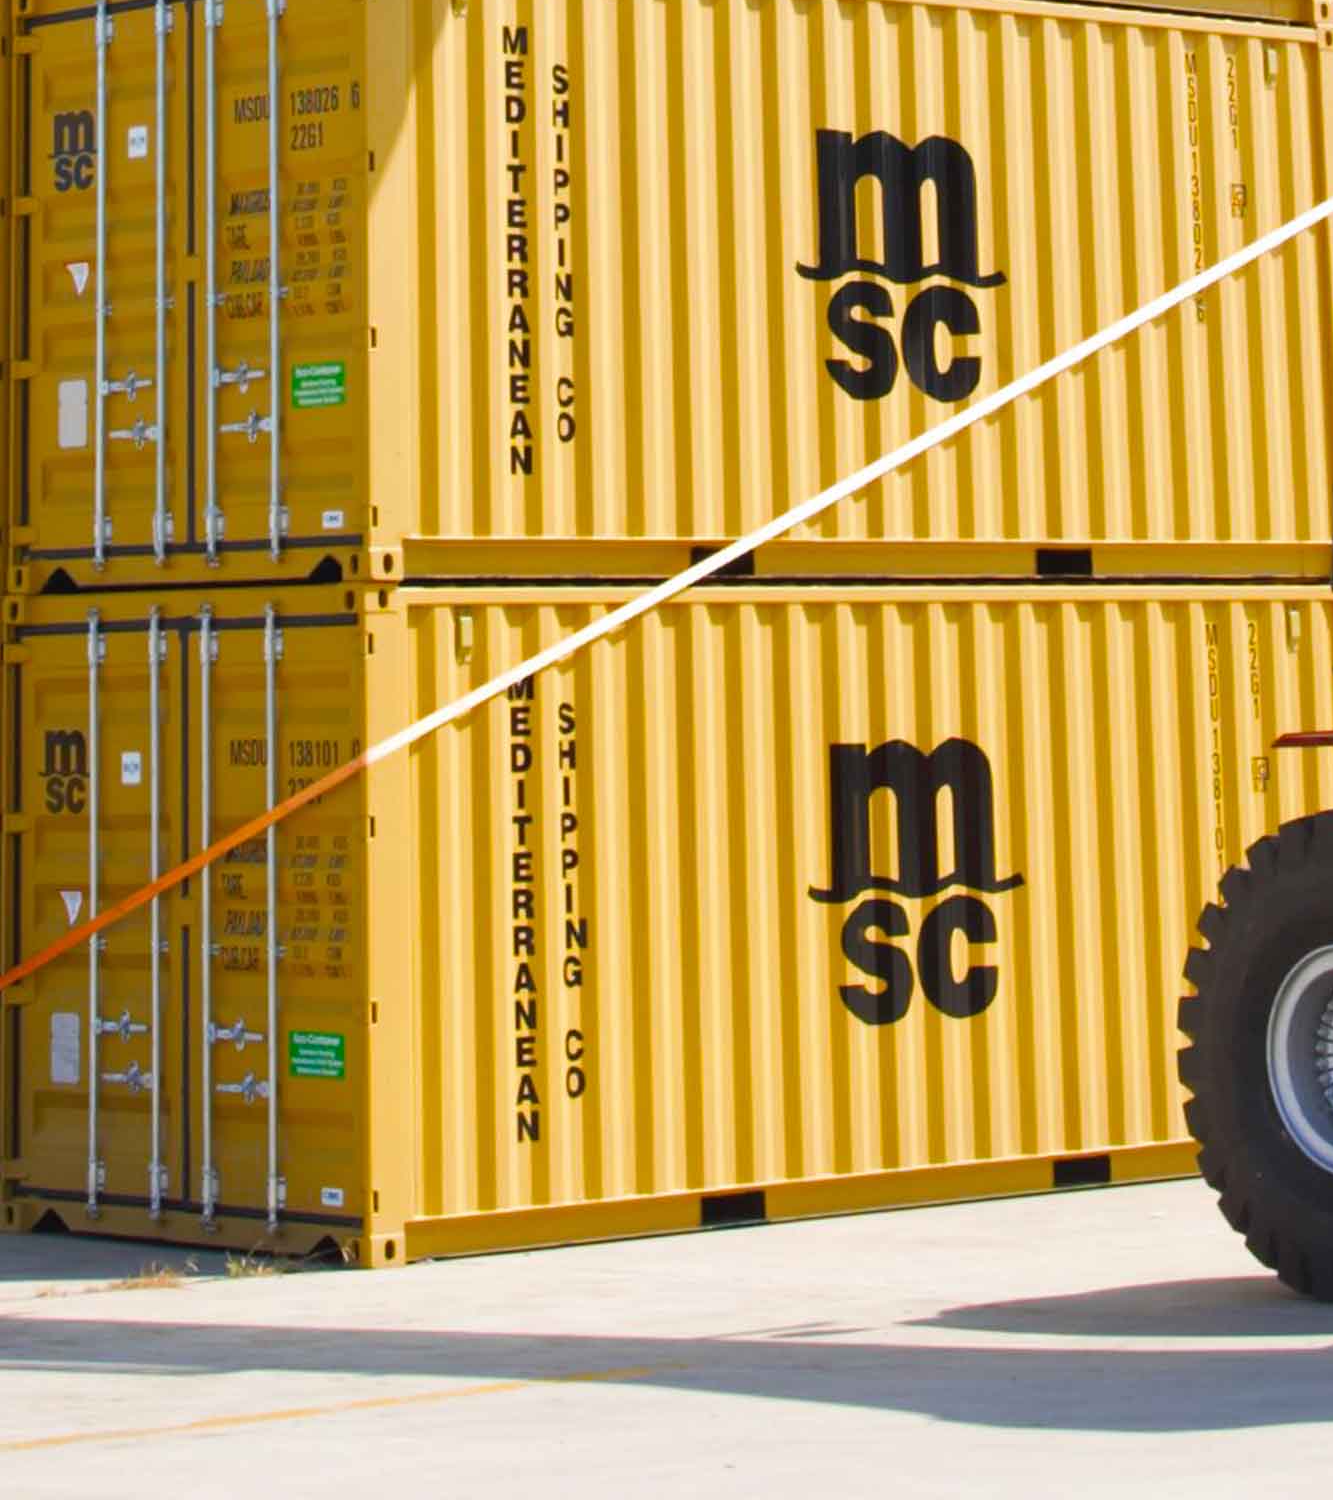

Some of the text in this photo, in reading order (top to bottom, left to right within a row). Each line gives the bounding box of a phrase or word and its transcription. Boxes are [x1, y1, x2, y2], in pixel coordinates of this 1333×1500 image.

[290, 84, 340, 117] 138026
[502, 26, 533, 476] MEDITERRANEAN
[551, 64, 576, 443] SHIPPING CO
[288, 739, 340, 768] 138101
[507, 675, 540, 1144] MEDITERRANEAN
[558, 701, 587, 1099] SHIPPING CO
